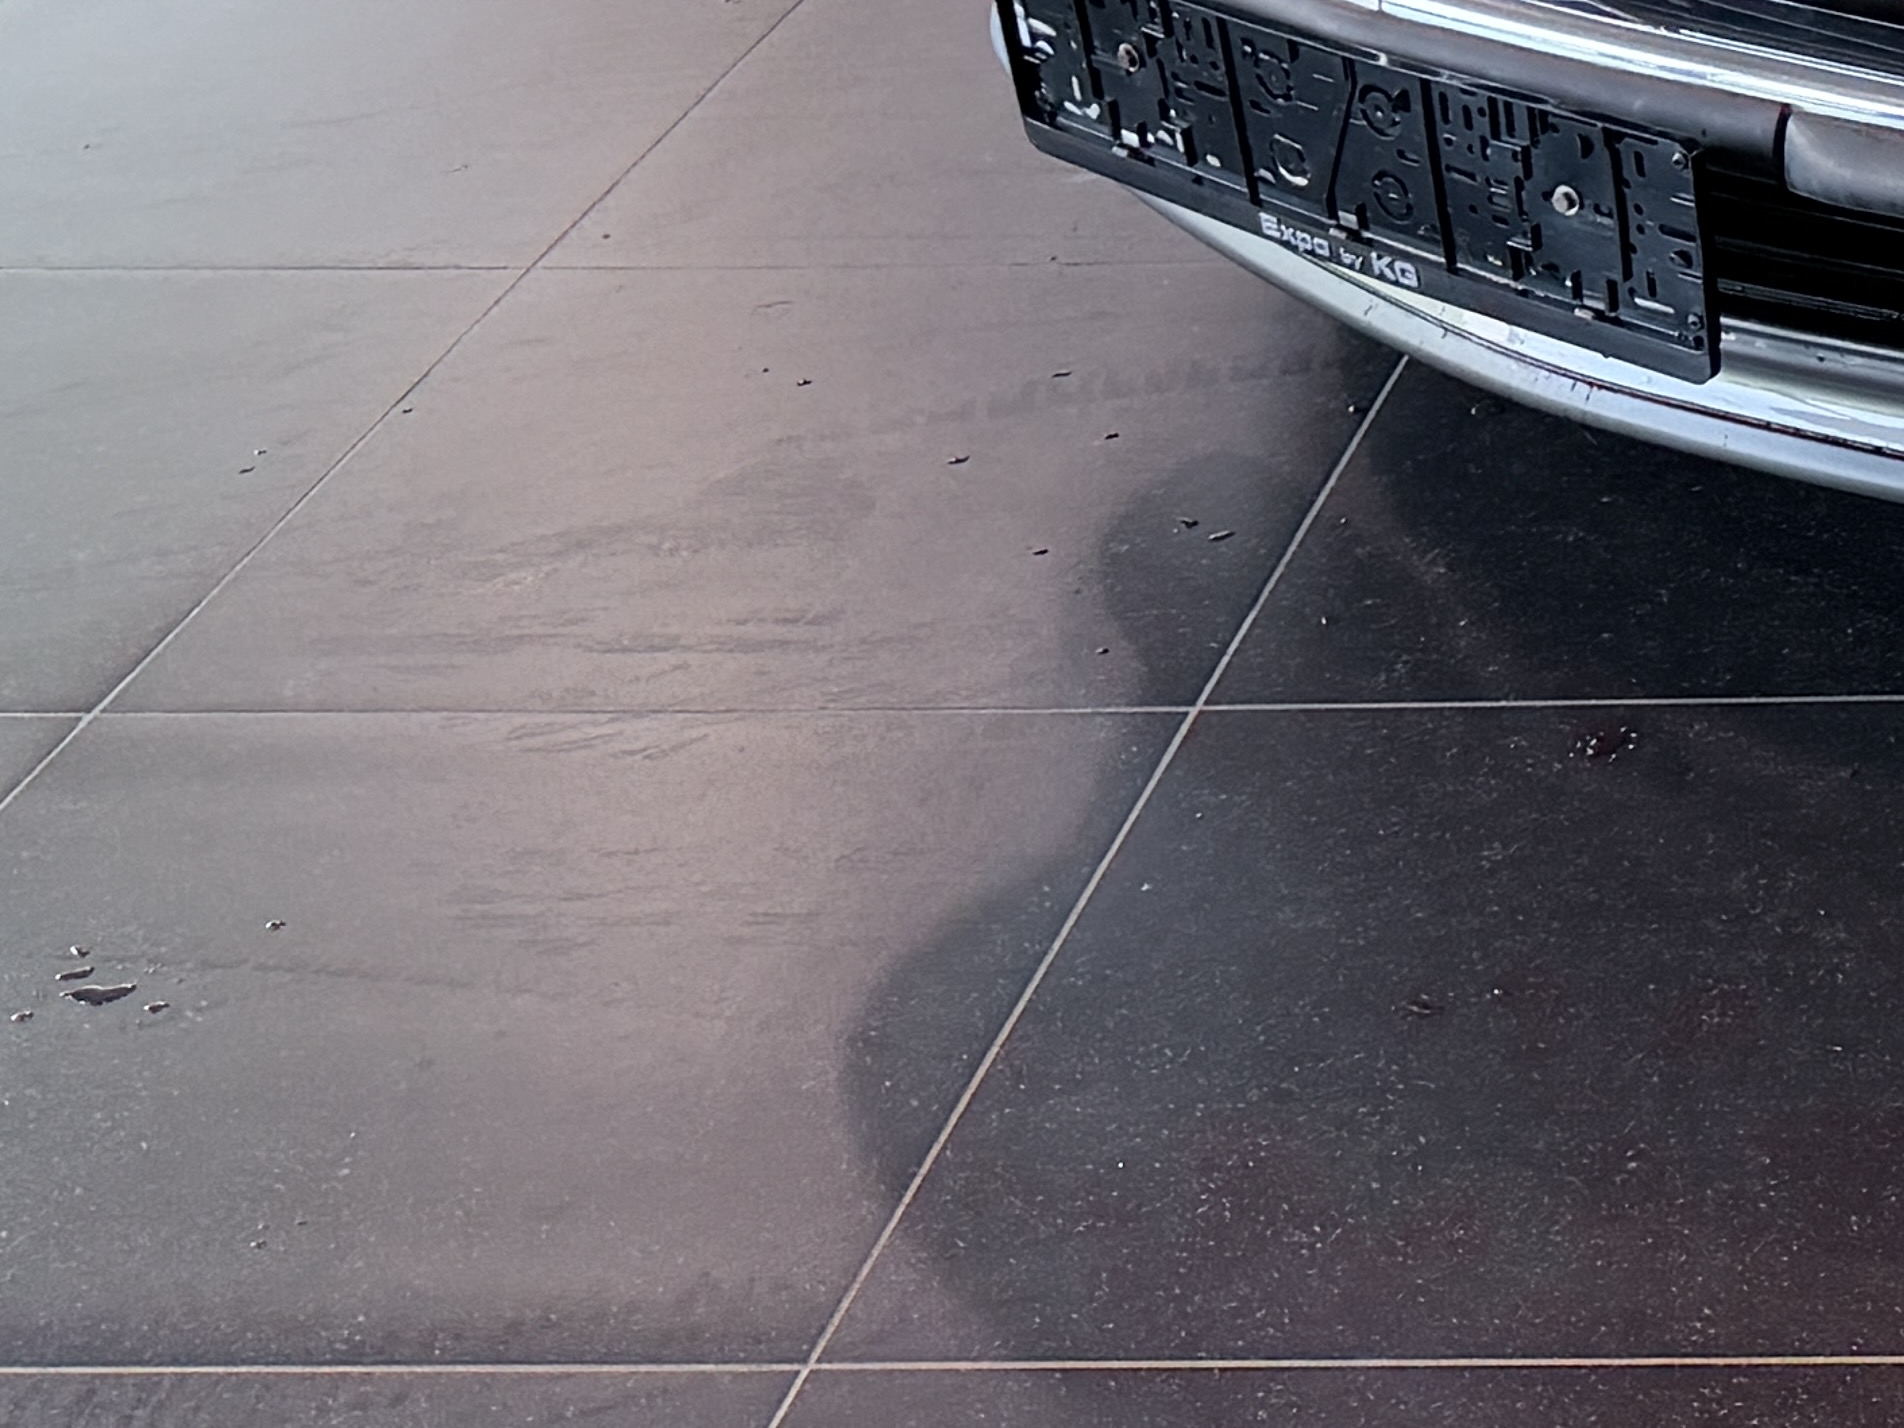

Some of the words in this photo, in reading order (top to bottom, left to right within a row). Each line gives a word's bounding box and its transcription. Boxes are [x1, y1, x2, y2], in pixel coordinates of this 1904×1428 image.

[1258, 211, 1331, 256] Expo
[1339, 246, 1364, 271] by
[1369, 250, 1420, 288] KG
